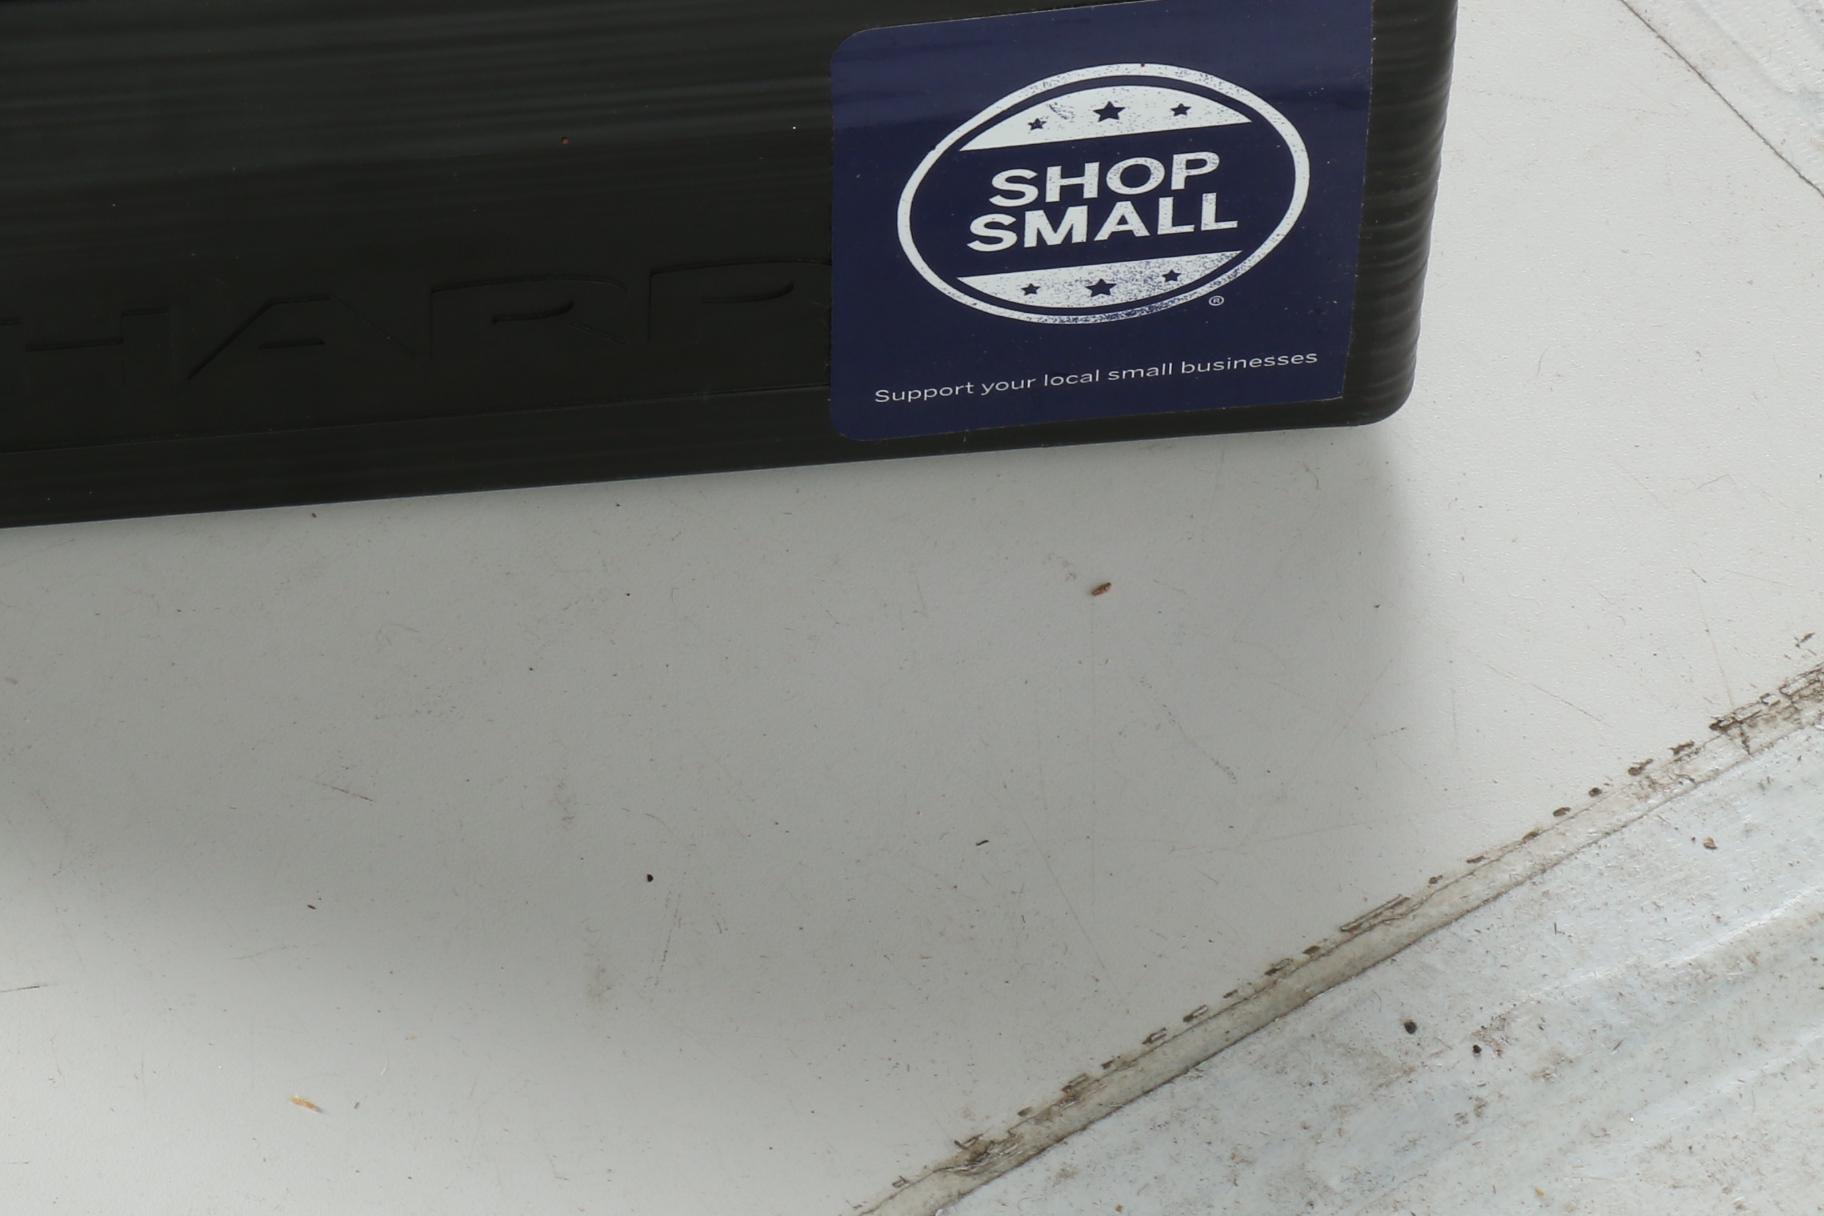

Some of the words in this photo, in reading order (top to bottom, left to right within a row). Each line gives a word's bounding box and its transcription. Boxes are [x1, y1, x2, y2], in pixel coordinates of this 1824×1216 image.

[989, 151, 1220, 207] SHOP
[966, 193, 1238, 252] SMALL
[874, 382, 974, 403] Support
[981, 378, 1036, 396] your
[1044, 369, 1100, 387] local
[1108, 362, 1173, 381] small
[1181, 352, 1318, 374] businesses
